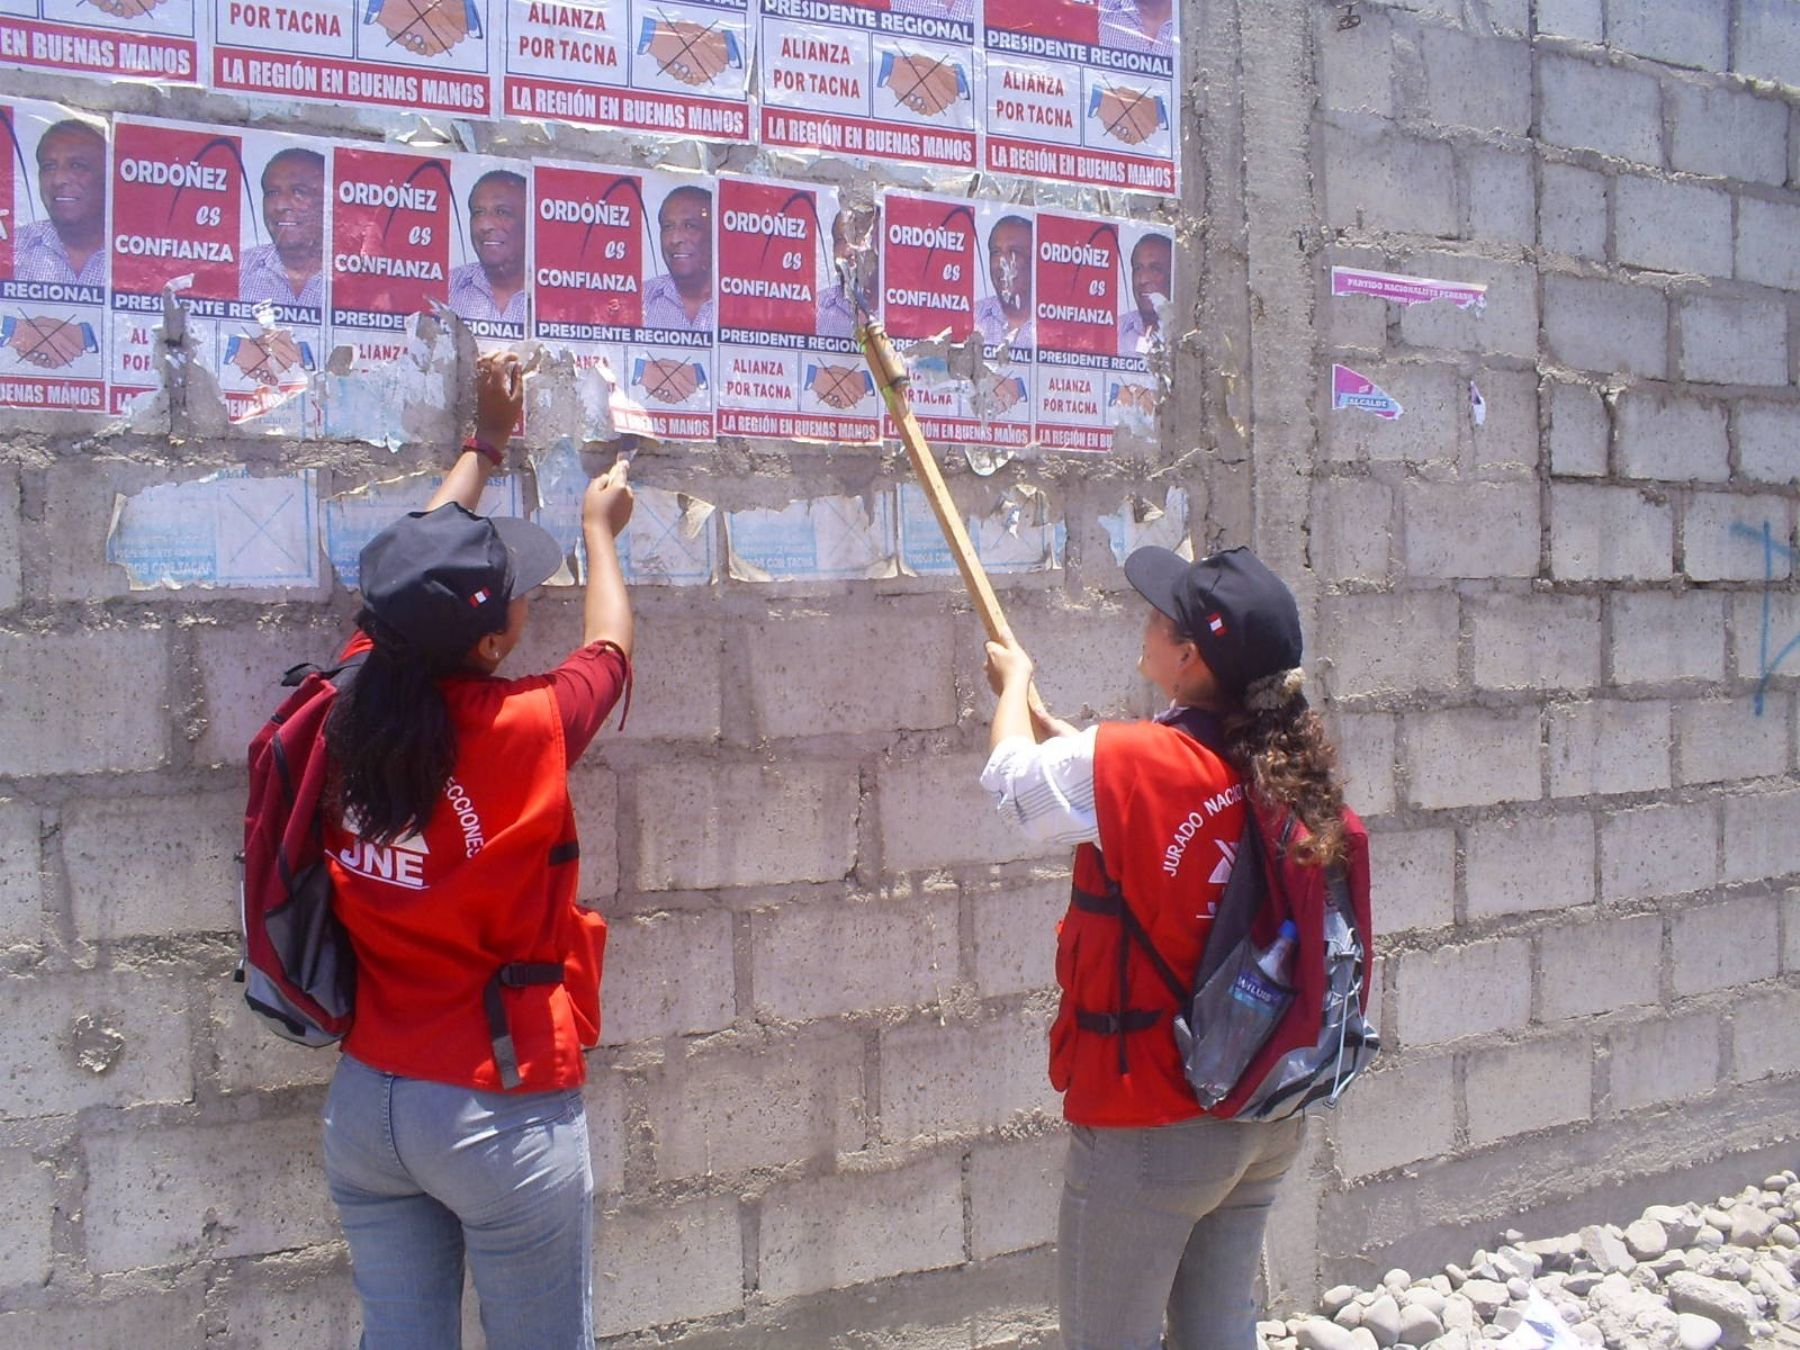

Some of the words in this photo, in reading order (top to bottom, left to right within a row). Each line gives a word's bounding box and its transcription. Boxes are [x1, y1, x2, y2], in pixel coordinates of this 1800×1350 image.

[230, 2, 270, 29] POR
[276, 8, 341, 37] TACNA
[528, 2, 606, 31] ALIANZA
[764, 0, 876, 27] PRESIDENTE
[881, 14, 973, 43] REGIONAL
[33, 31, 115, 69] BUENAS
[119, 42, 190, 75] MANOS
[519, 35, 555, 59] POR
[559, 40, 618, 66] TACNA
[781, 37, 851, 65] ALIANZA
[987, 30, 1087, 62] PRESIDENTE
[1090, 47, 1172, 75] REGIONAL
[222, 57, 245, 84] LA
[249, 60, 317, 92] REGIÓN
[321, 69, 343, 95] EN
[348, 71, 418, 102] BUENAS
[421, 78, 485, 109] MANOS
[773, 68, 805, 92] POR
[809, 73, 860, 98] TACNA
[1003, 70, 1064, 97] ALIANZA
[512, 85, 532, 112] LA
[535, 87, 596, 118] REGIÓN
[600, 95, 620, 120] EN
[623, 98, 685, 128] BUENAS
[688, 106, 744, 134] MANOS
[996, 99, 1024, 121] POR
[1029, 104, 1073, 128] TACNA
[768, 116, 786, 141] LA
[789, 120, 842, 147] REGIÓN
[845, 126, 863, 148] EN
[865, 129, 920, 157] BUENAS
[923, 135, 972, 162] MANOS
[991, 144, 1008, 168] LA
[1010, 148, 1057, 174] REGIÓN
[1059, 155, 1075, 177] EN
[1077, 157, 1126, 183] BUENAS
[1128, 163, 1171, 188] MANOS
[195, 205, 221, 226] es
[408, 226, 432, 245] es
[115, 234, 234, 262] CONFIANZA
[604, 240, 625, 259] es
[782, 251, 802, 269] es
[335, 253, 443, 280] CONFIANZA
[3, 281, 103, 303] REGIONAL
[537, 268, 637, 292] CONFIANZA
[720, 276, 812, 301] CONFIANZA
[1089, 279, 1106, 296] es
[886, 288, 970, 311] CONFIANZA
[1038, 303, 1114, 326] CONFIANZA
[539, 322, 631, 342] PRESIDENTE
[635, 329, 712, 346] REGIONAL
[721, 328, 805, 348] PRESIDENTE
[733, 358, 784, 376] ALIANZA
[1039, 350, 1109, 368] PRESIDENTE
[47, 385, 100, 406] MANOS
[727, 380, 750, 397] POR
[753, 382, 791, 399] TACNA
[1049, 377, 1091, 393] ALIANZA
[1043, 398, 1064, 412] POR
[1066, 399, 1098, 414] TACNA
[669, 419, 709, 436] MANOS
[722, 415, 736, 431] LA
[738, 414, 778, 434] REGIÓN
[780, 420, 793, 434] EN
[794, 420, 836, 438] BUENAS
[838, 423, 876, 440] MANOS
[994, 425, 1029, 443] MANOS
[1039, 429, 1052, 443] LA
[1088, 433, 1099, 447] EN
[1162, 811, 1204, 878] JURADO
[339, 838, 424, 886] JNE
